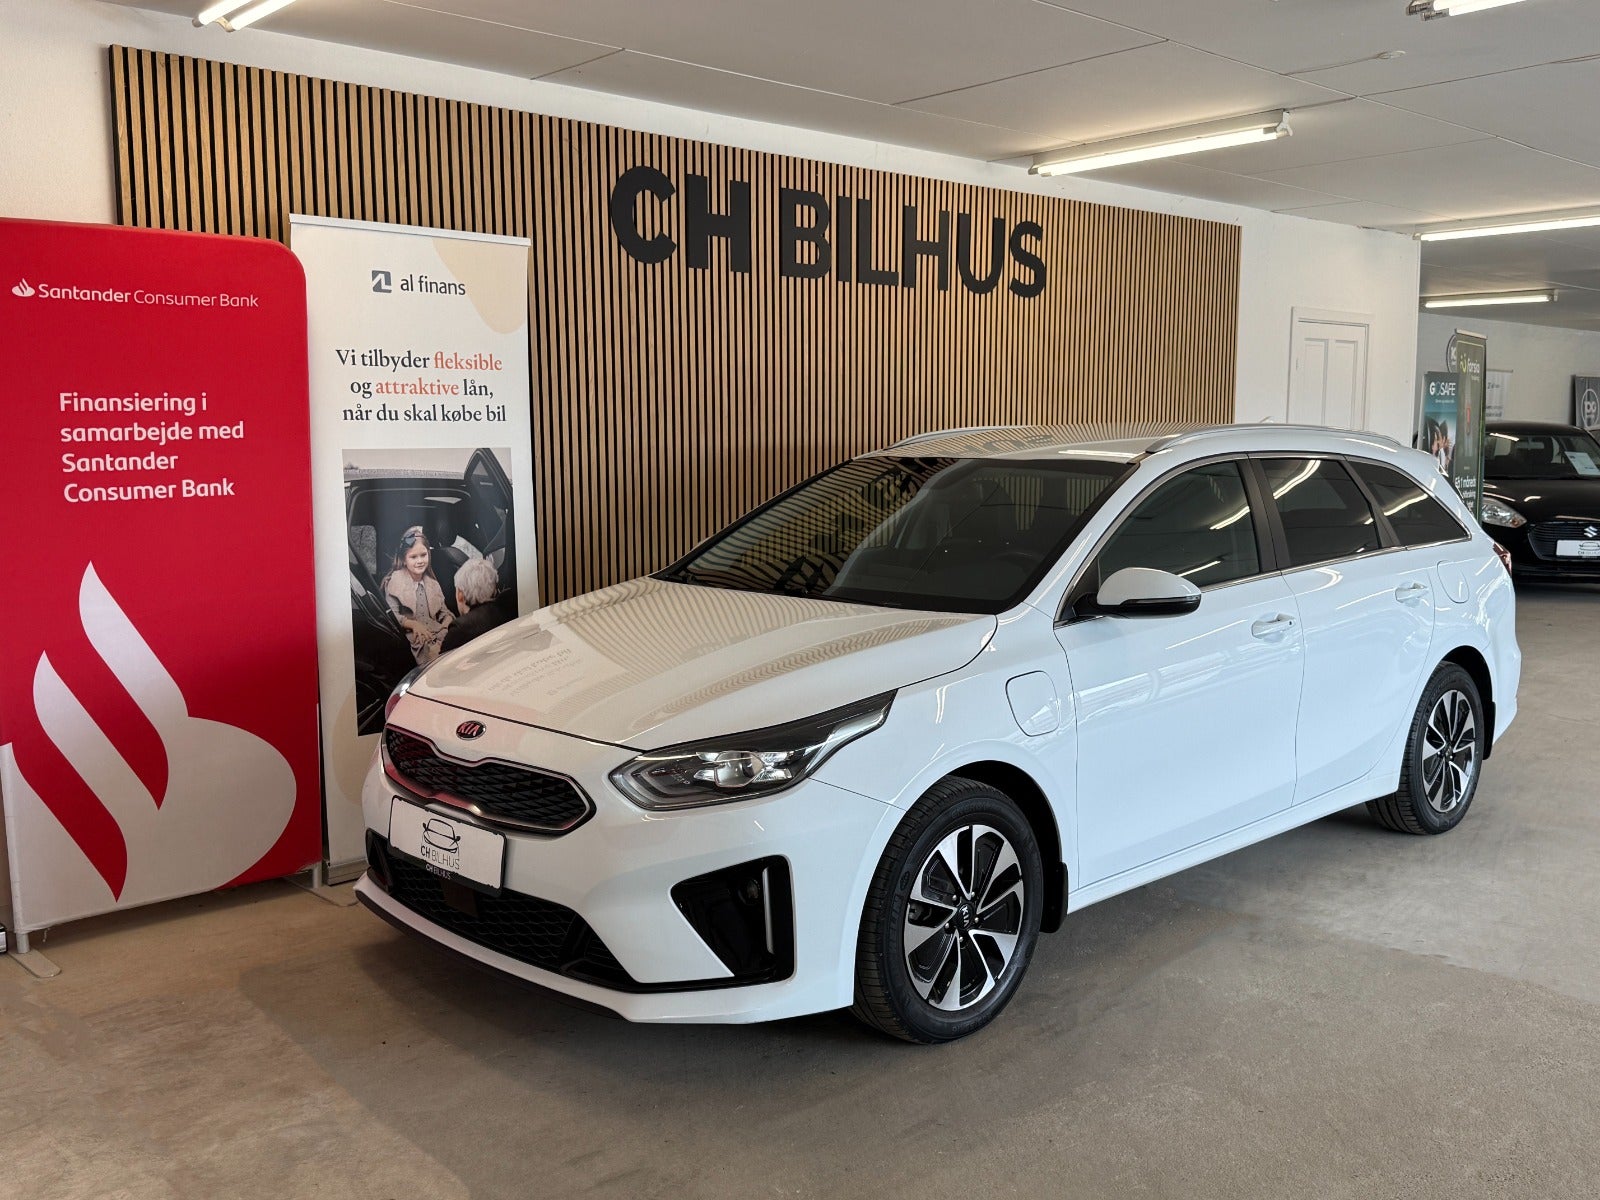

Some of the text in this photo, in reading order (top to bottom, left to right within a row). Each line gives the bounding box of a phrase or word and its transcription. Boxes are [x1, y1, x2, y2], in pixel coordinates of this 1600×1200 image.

[610, 165, 1047, 299] CH BILHUS
[38, 283, 259, 308] Santander Consumer Bank
[400, 274, 466, 296] al finans
[335, 349, 503, 373] Vi tilbyder fleksible
[350, 377, 494, 399] og attraktive lån,
[59, 391, 207, 416] Finansiering i
[342, 403, 507, 423] når du skal købe bil
[60, 420, 245, 446] samarbejde med
[61, 451, 179, 473] Santander
[63, 477, 236, 503] Consumer Bank
[457, 722, 480, 737] KIA
[420, 845, 460, 870] CH BILHUS
[961, 905, 970, 928] KIA
